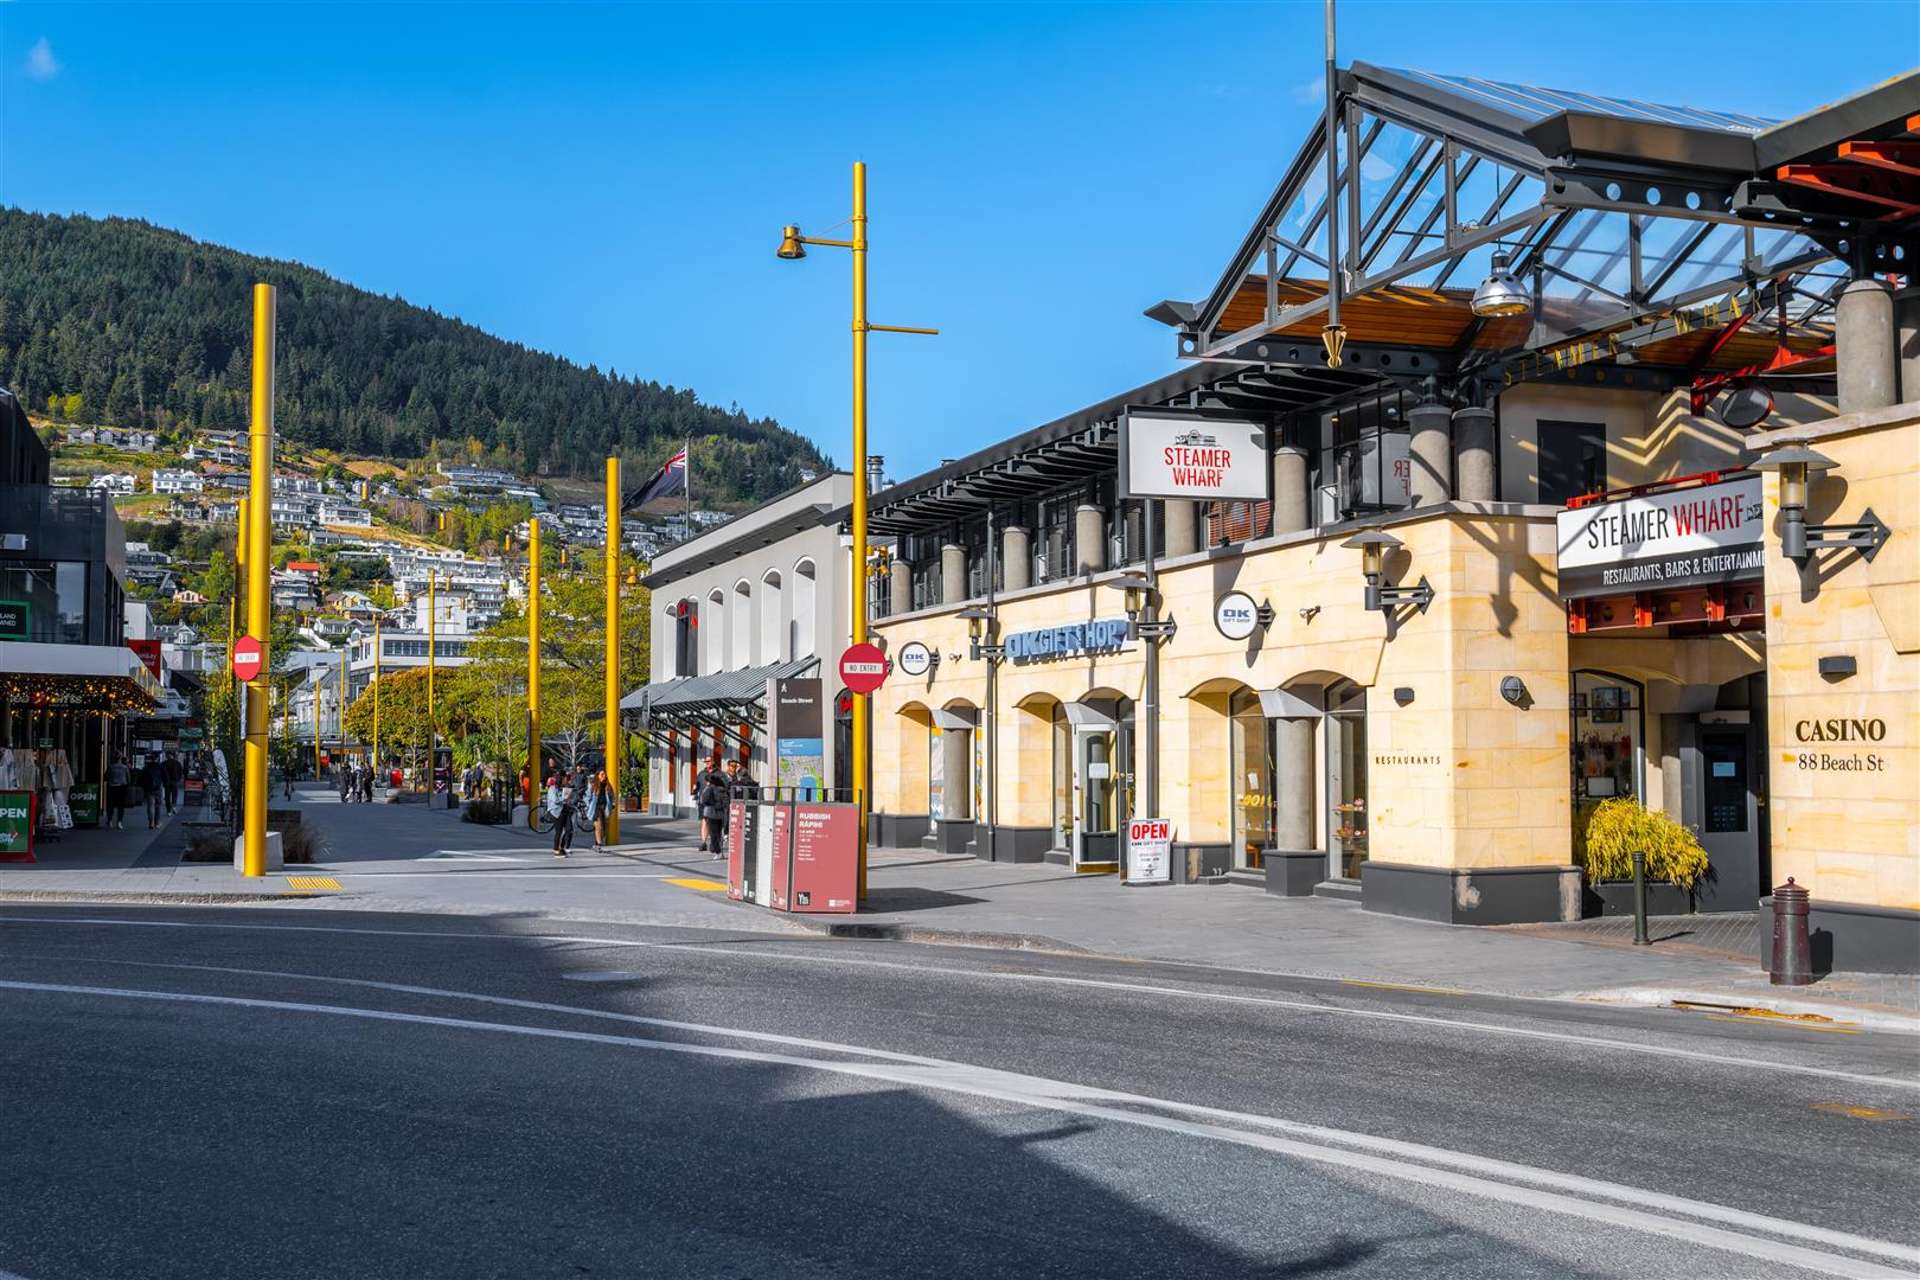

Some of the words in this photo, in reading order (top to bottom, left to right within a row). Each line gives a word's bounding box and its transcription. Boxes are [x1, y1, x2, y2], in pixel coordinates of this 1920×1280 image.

[1164, 447, 1231, 469] STEAMER
[1172, 467, 1224, 487] WHARF
[1587, 507, 1669, 549] STEAMER
[1673, 494, 1745, 537] WHARF
[1603, 565, 1663, 585] RESTAURANTS,
[1666, 559, 1691, 577] BARS
[1693, 559, 1700, 574] &
[1075, 619, 1124, 648] SHOP
[1795, 719, 1886, 742] CASINO
[1375, 756, 1441, 765] RESTAURANTS
[1798, 753, 1817, 770] 88
[1820, 754, 1862, 771] Beach
[1867, 754, 1884, 771] St
[70, 792, 97, 801] OPEN
[1132, 824, 1168, 840] OPEN
